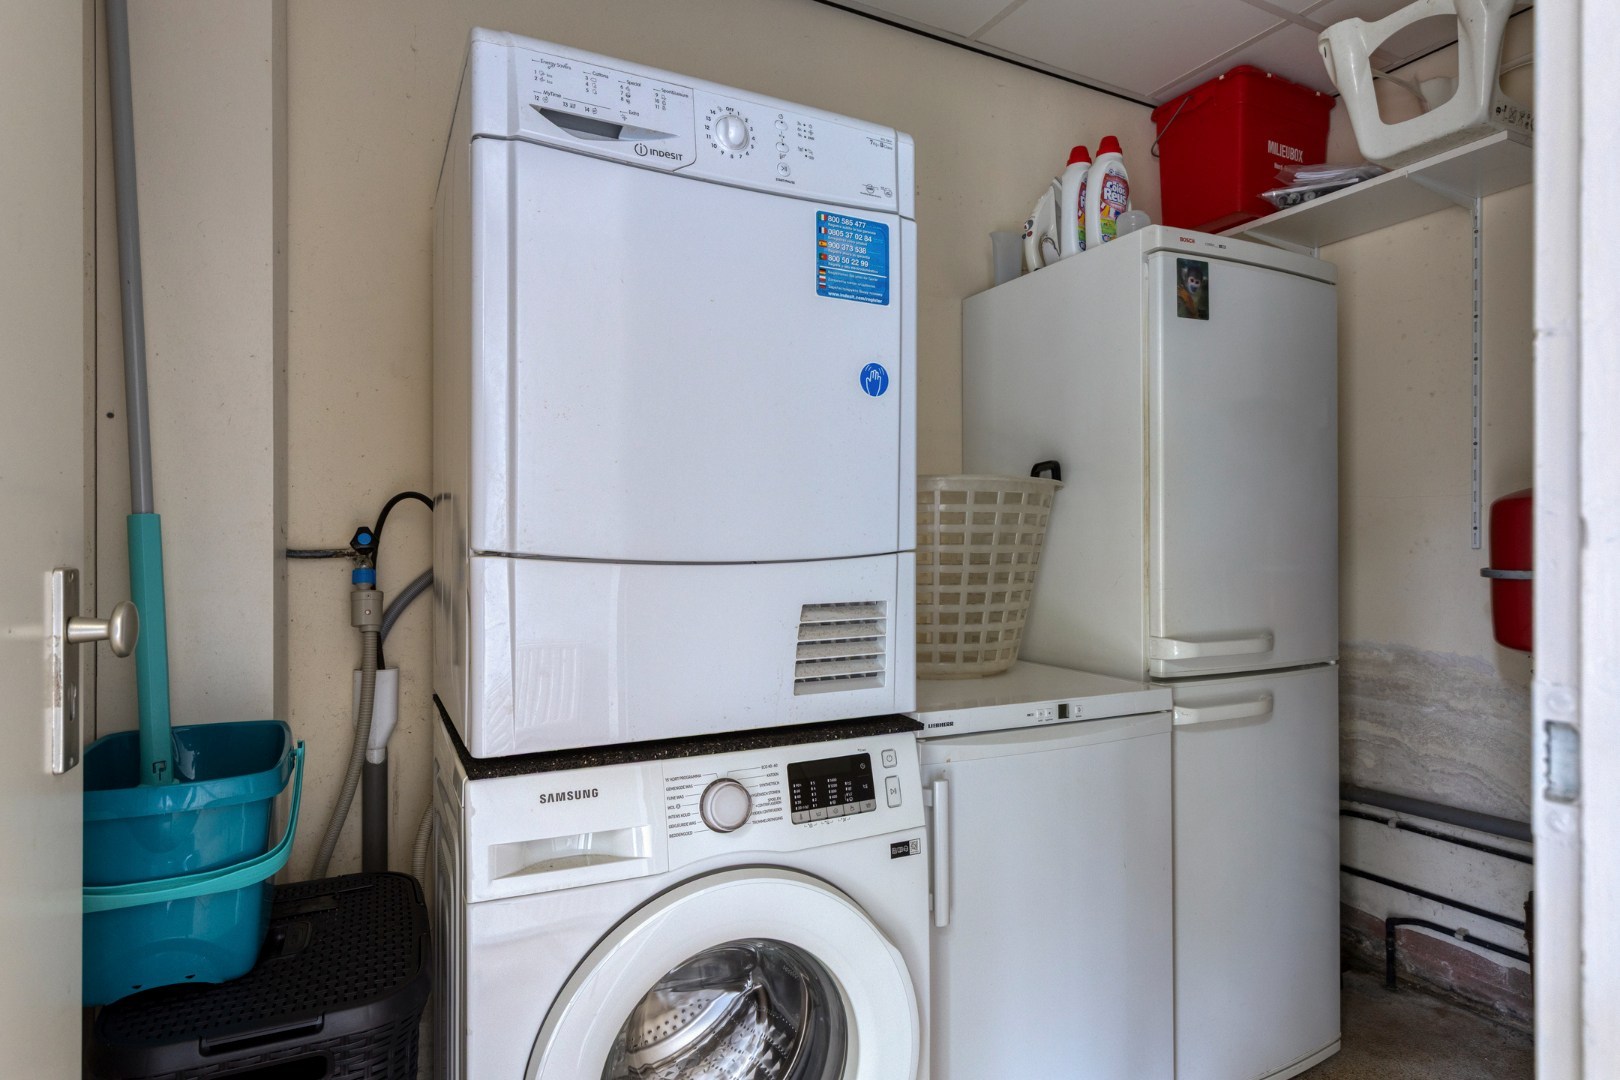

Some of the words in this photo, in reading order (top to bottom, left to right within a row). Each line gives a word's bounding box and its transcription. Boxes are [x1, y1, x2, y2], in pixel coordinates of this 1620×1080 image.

[1268, 140, 1303, 163] MILIEUBOX
[1104, 188, 1127, 205] Reus
[540, 788, 598, 804] SAMSUNG
